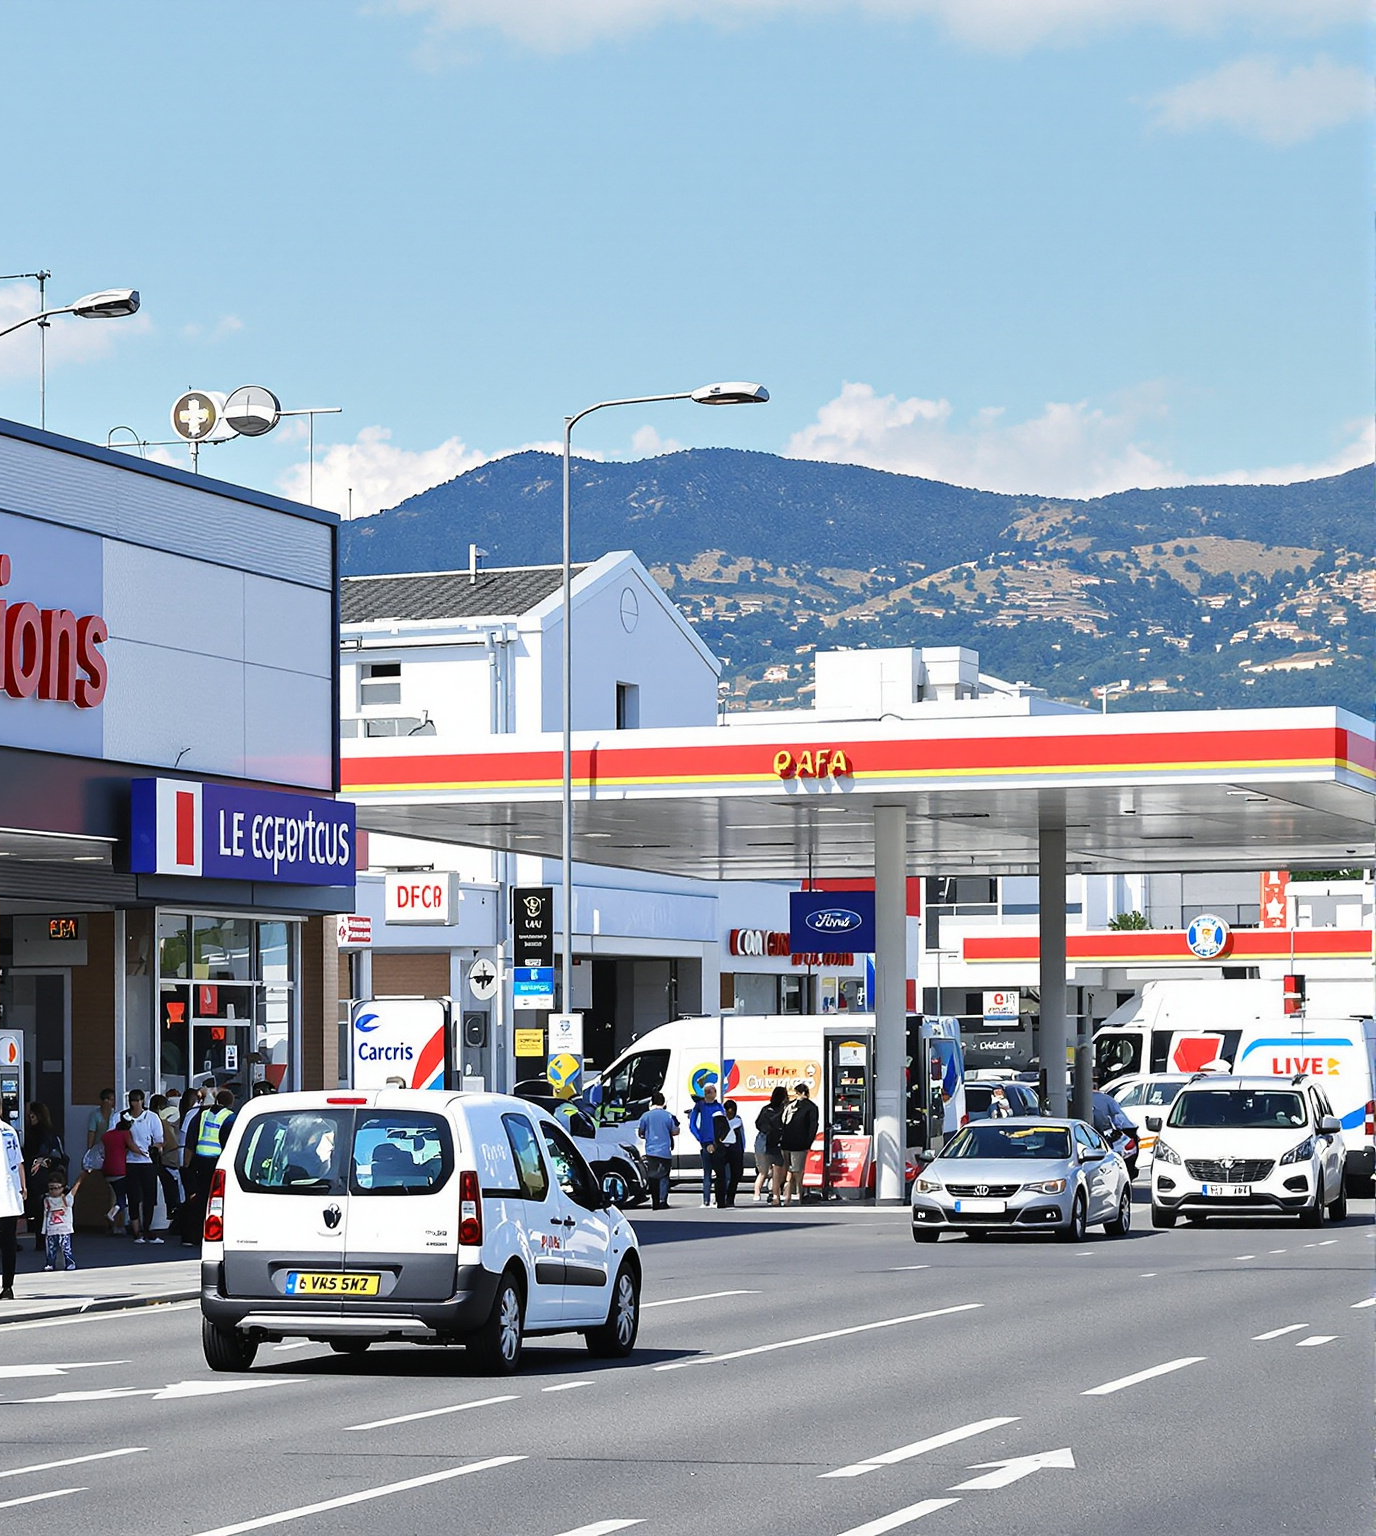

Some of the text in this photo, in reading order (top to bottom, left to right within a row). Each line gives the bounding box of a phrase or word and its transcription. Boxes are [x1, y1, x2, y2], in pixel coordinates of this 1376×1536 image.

[219, 809, 245, 858] LE
[358, 1041, 414, 1061] Carcris
[1272, 1057, 1324, 1075] LIVE
